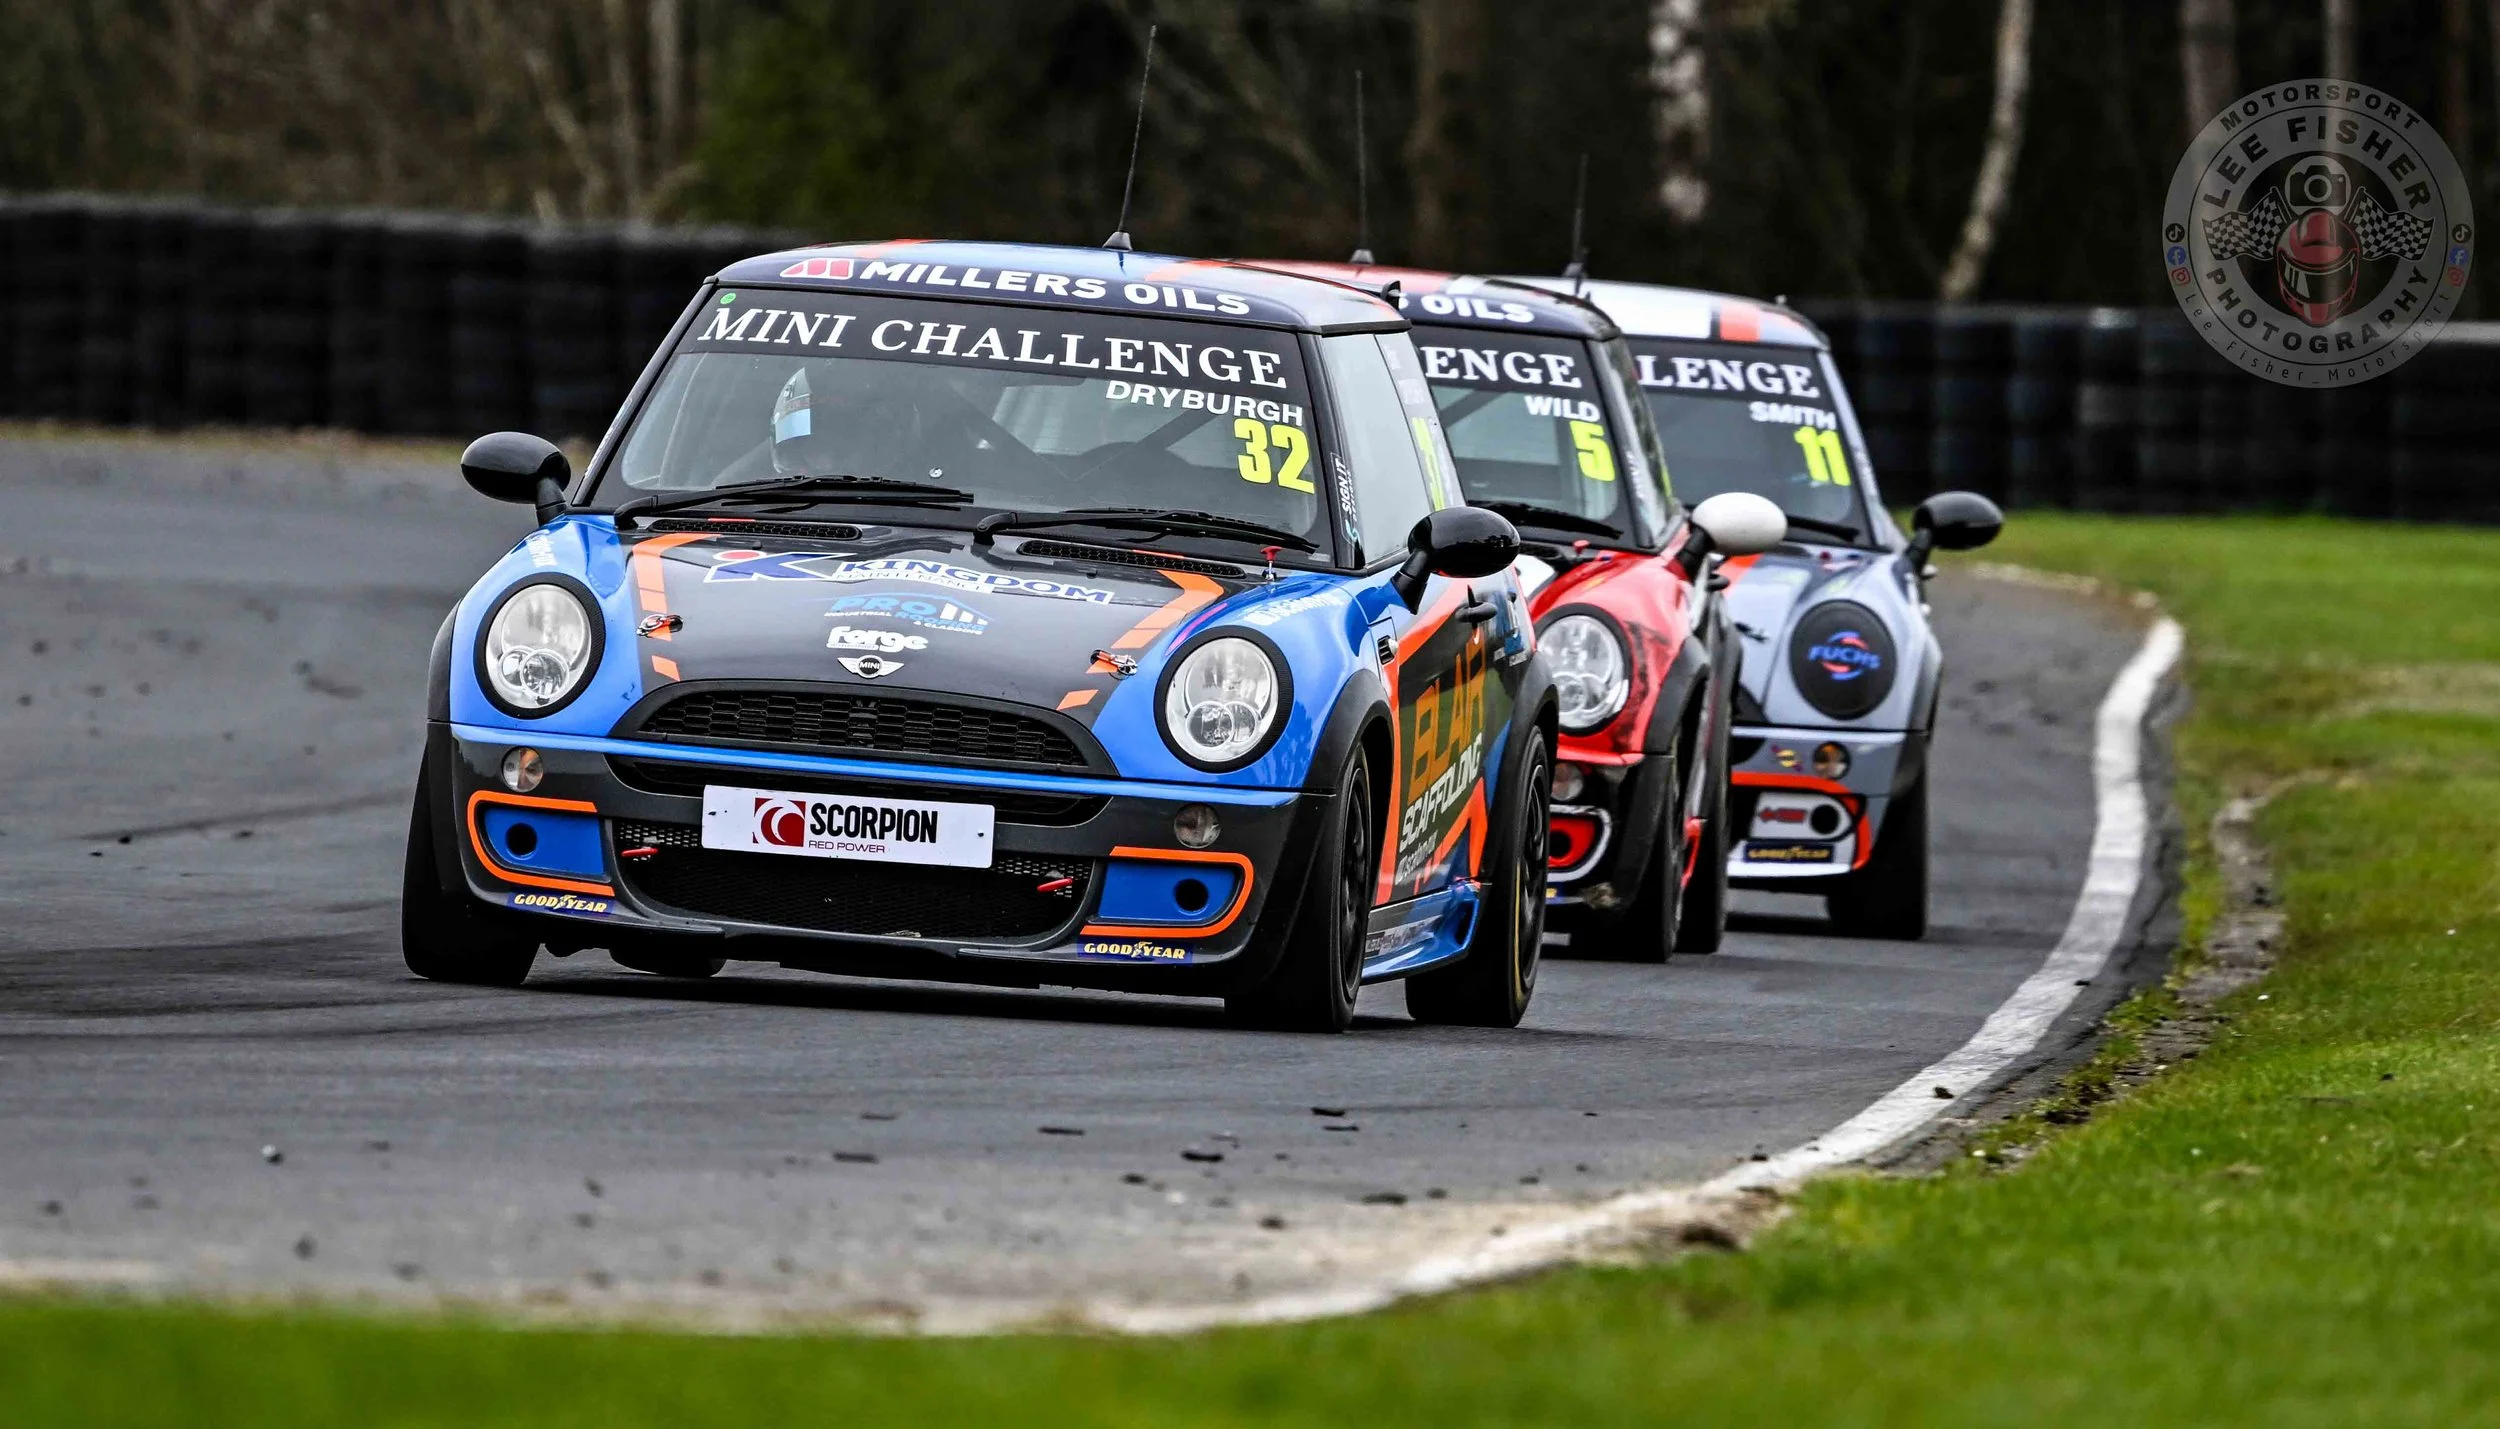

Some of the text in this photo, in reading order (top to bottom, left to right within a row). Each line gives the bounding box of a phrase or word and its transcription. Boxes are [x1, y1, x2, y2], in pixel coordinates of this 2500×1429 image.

[860, 260, 1250, 315] MILLERS OILS
[1420, 294, 1535, 324] OILS
[697, 307, 1287, 389] MINI CHALLENGE
[1105, 380, 1303, 427] DRYBURGH
[1524, 394, 1600, 422] WILD
[1749, 401, 1836, 430] SMITH
[1234, 418, 1315, 494] 32
[1569, 420, 1615, 482] 5
[1793, 425, 1851, 487] 11
[842, 560, 1111, 601] KINGDOM
[829, 597, 937, 616] PRO
[859, 661, 880, 671] MINI
[1808, 644, 1881, 669] FUCHS
[1407, 632, 1486, 806] BLAIR
[1398, 733, 1482, 854] SCAFFOLDING
[809, 802, 938, 844] SCORPION
[808, 841, 885, 853] RED POWER
[514, 893, 608, 912] GOODYEAR
[1083, 941, 1186, 960] GOODYEAR
